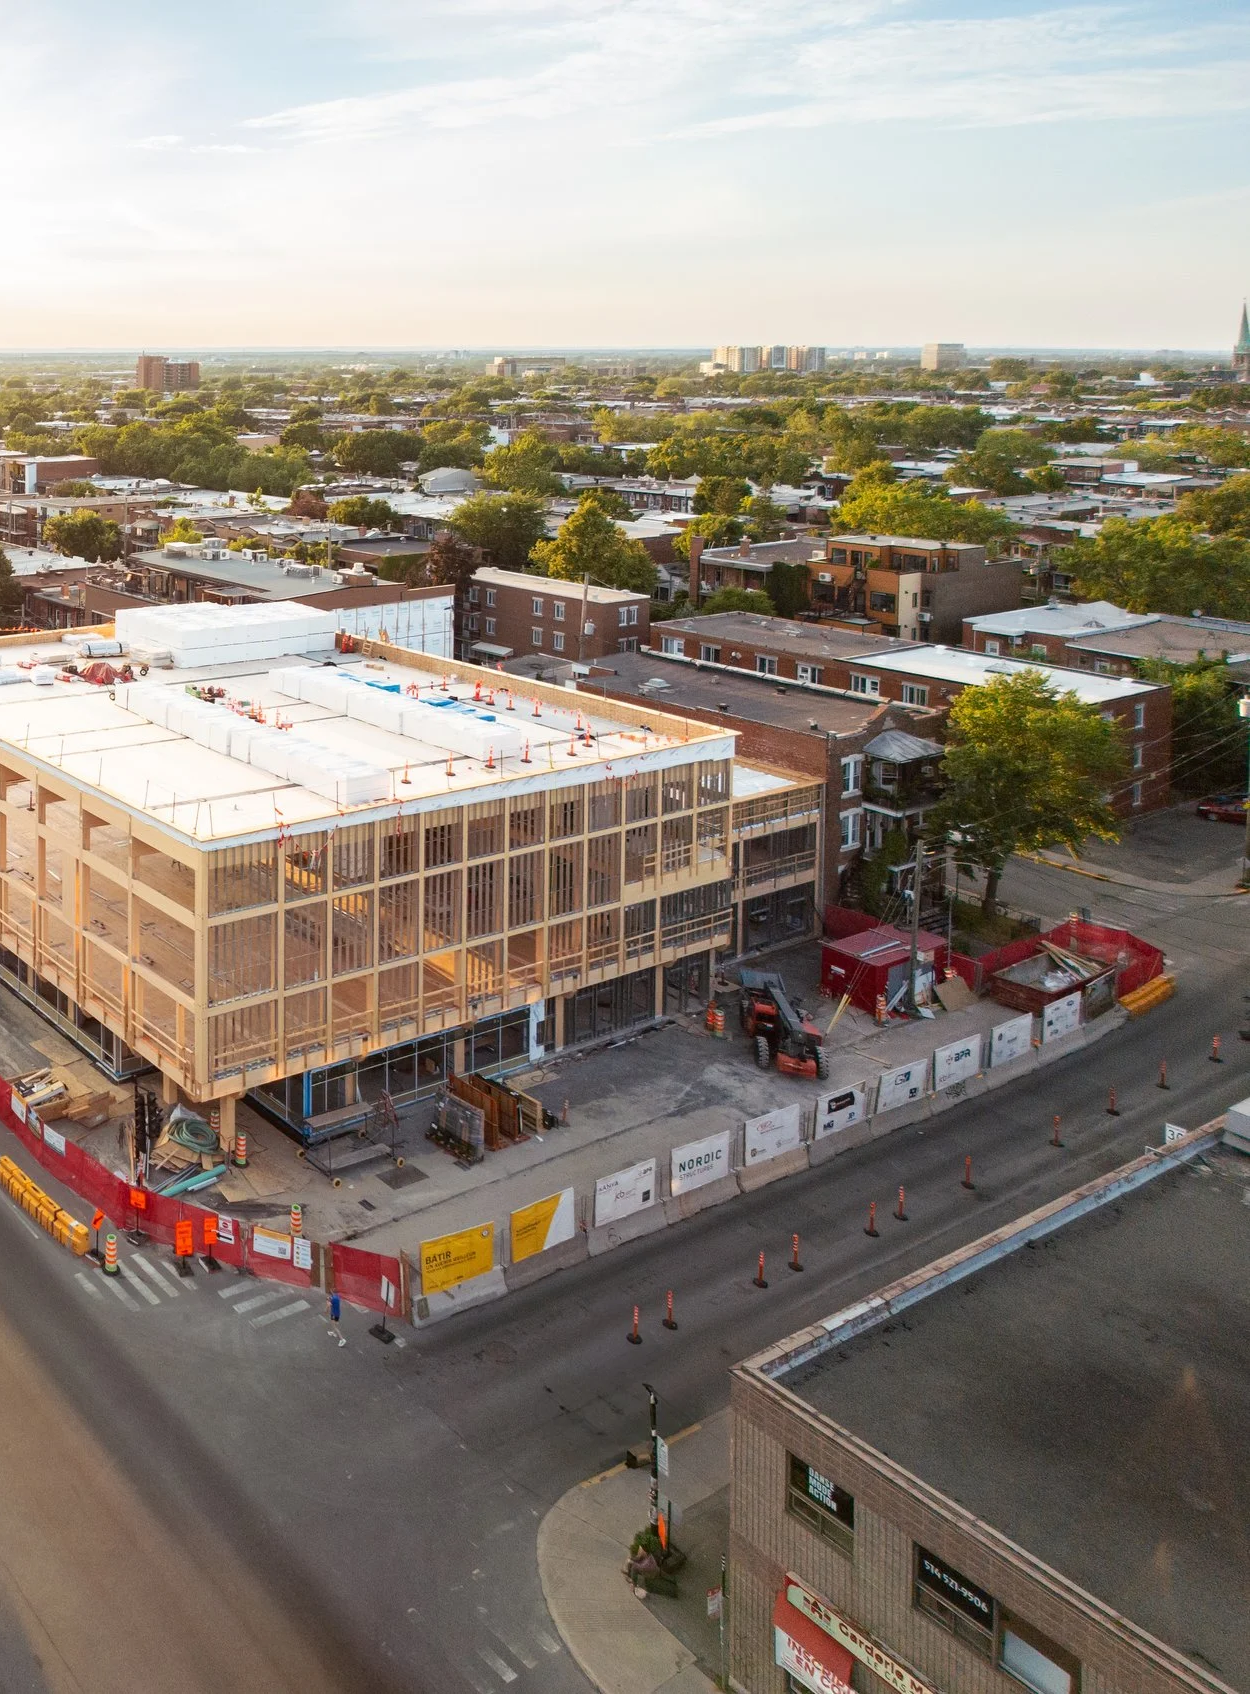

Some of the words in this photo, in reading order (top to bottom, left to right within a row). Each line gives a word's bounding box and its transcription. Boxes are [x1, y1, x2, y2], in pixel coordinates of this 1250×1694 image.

[679, 1149, 722, 1173] NORDIC
[679, 1163, 714, 1181] STRUCTURES
[808, 1466, 835, 1492] DANSE
[808, 1475, 833, 1500] MODE
[808, 1484, 837, 1512] ACTION
[924, 1559, 942, 1579] 514
[942, 1573, 989, 1613] 521-9506
[838, 1622, 904, 1682] Garderie
[866, 1656, 879, 1671] LE
[795, 1654, 815, 1678] EN
